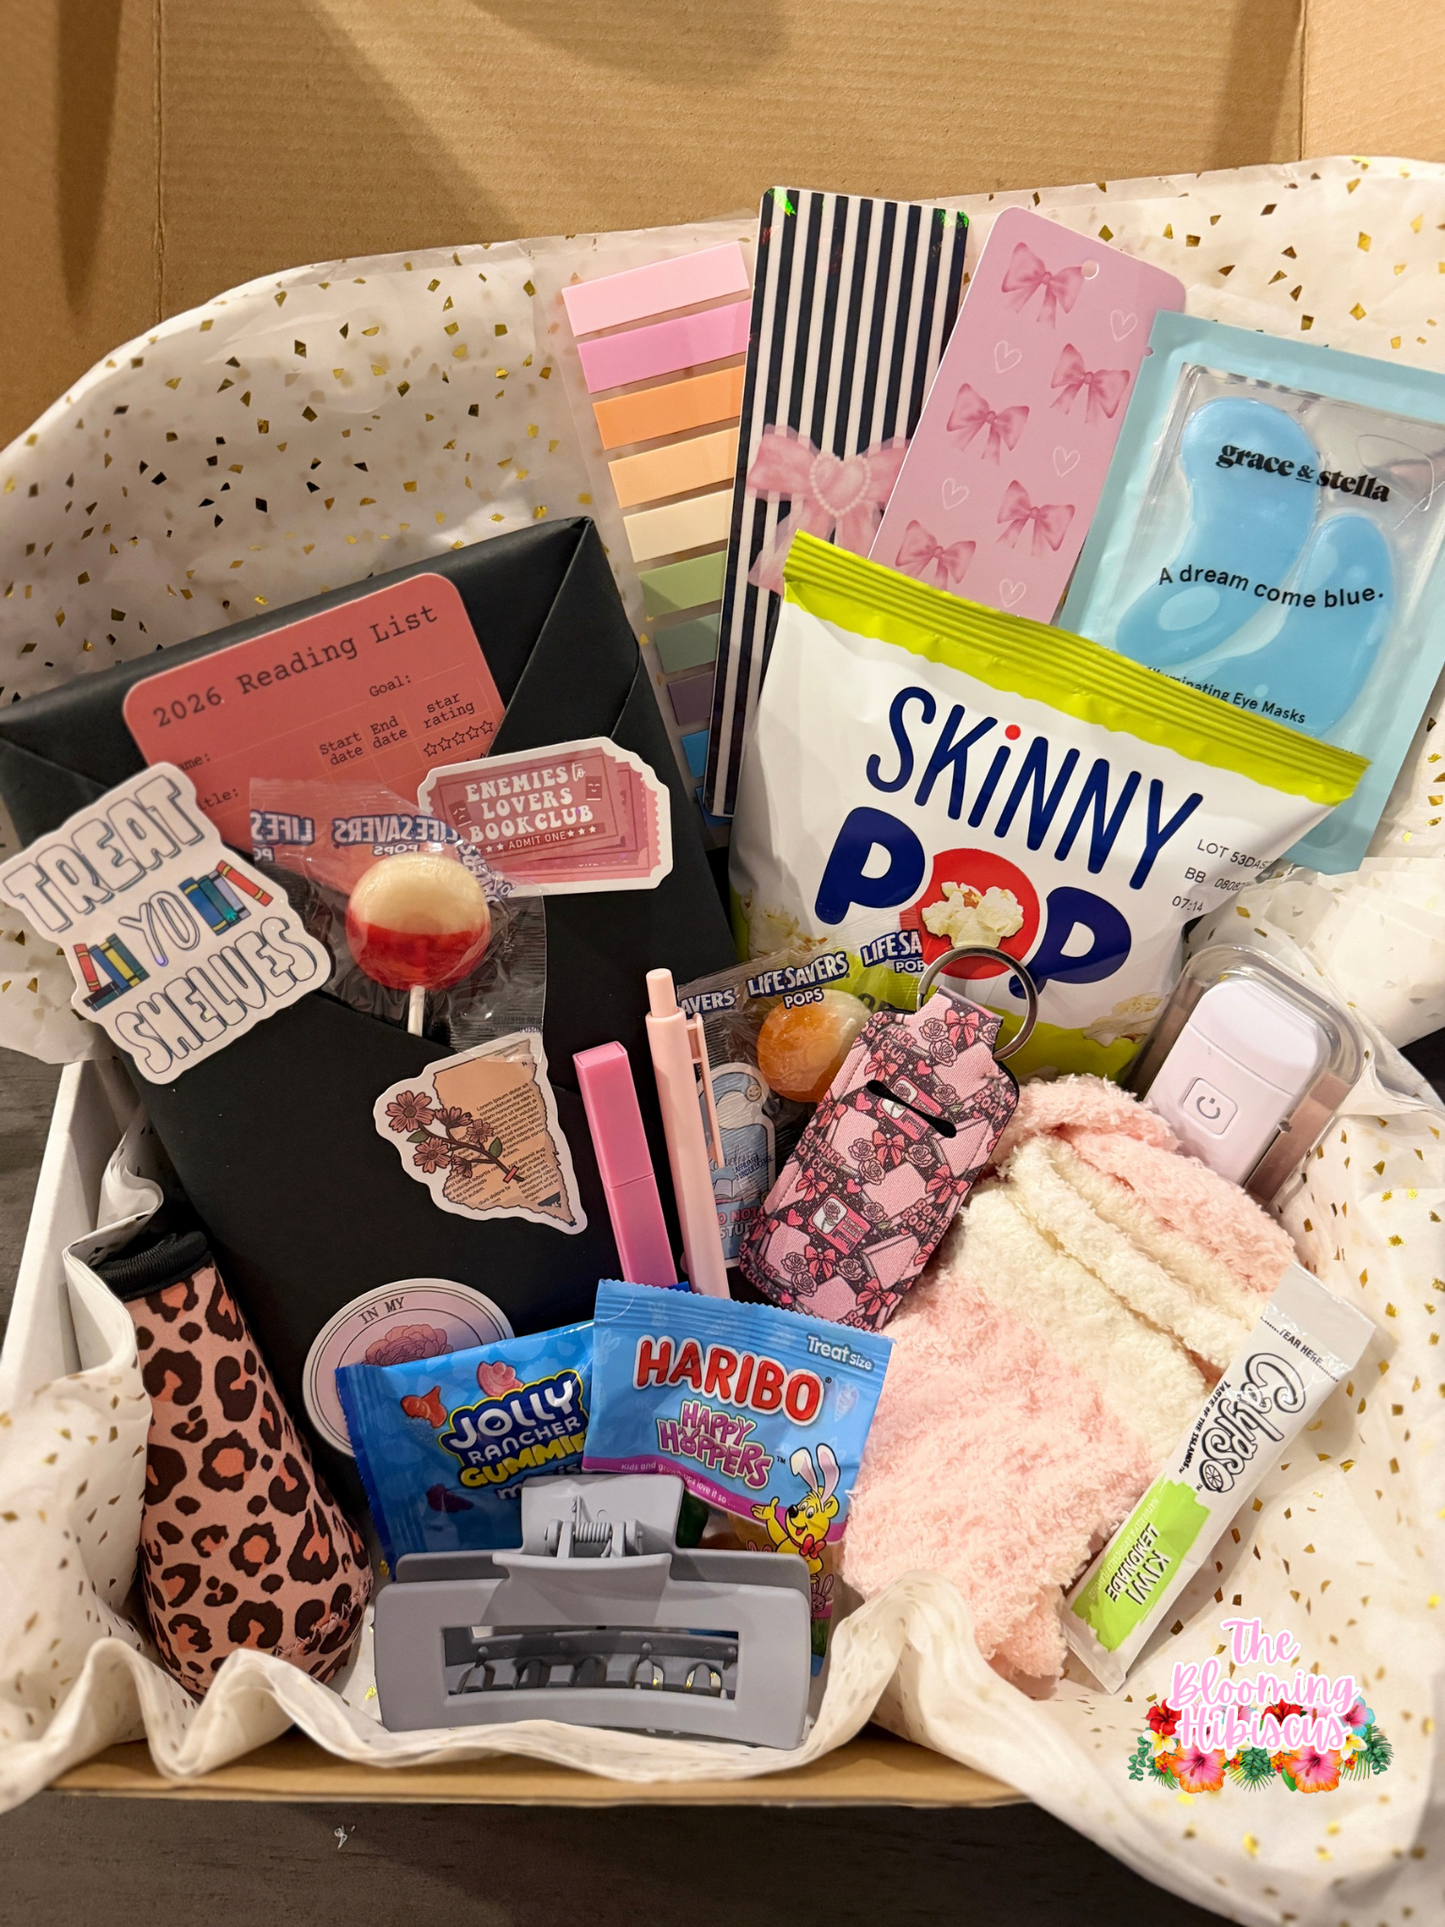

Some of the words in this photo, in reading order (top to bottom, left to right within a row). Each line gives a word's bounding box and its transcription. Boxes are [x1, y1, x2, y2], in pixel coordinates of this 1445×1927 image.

[1215, 443, 1295, 477] grace
[1295, 464, 1315, 484] &
[1316, 467, 1390, 502] stella
[1158, 566, 1173, 586] A
[1179, 564, 1249, 592] dream
[1253, 583, 1316, 608] come
[1324, 585, 1385, 608] blue.
[153, 686, 221, 727] 2026
[236, 637, 358, 695] Reading
[369, 603, 438, 645] List
[368, 674, 412, 698] Goal:
[423, 700, 476, 730] rating
[426, 692, 461, 714] star
[1232, 692, 1258, 710] Eye
[1261, 702, 1306, 724] Masks
[370, 716, 399, 737] End
[372, 728, 408, 750] date
[319, 731, 362, 756] Start
[330, 745, 364, 767] date
[177, 753, 211, 772] ame:
[465, 766, 569, 803] ENEMIES
[571, 762, 586, 782] to
[481, 787, 573, 820] LOVERS
[3, 775, 205, 933] TREAT
[508, 834, 541, 850] ADMIT
[544, 830, 566, 843] ONE
[1197, 839, 1229, 858] LOT
[1184, 867, 1206, 884] BB
[1171, 895, 1203, 912] 07:14
[118, 890, 200, 967] YO
[115, 916, 317, 1074] SHELVES
[785, 988, 823, 1009] POPS
[879, 1038, 907, 1064] CLUB
[810, 1157, 837, 1182] CLUB
[358, 1307, 379, 1325] IN
[385, 1297, 405, 1314] MY
[808, 1335, 849, 1362] Treat
[1280, 1329, 1301, 1348] TEAR
[1300, 1344, 1323, 1366] HERE
[635, 1337, 822, 1424] HARIBO
[1211, 1380, 1231, 1408] TASTE
[450, 1380, 574, 1449] JOLLY
[681, 1401, 755, 1447] HAPPY
[1196, 1417, 1205, 1432] THE
[1199, 1352, 1306, 1493] Calypso
[1203, 1406, 1211, 1419] OF
[468, 1416, 581, 1465] RANCHER
[657, 1419, 774, 1488] HOPPERS
[621, 1463, 639, 1471] Kids
[640, 1461, 656, 1470] and
[696, 1480, 711, 1496] love
[712, 1490, 718, 1499] it
[718, 1493, 727, 1504] so
[1104, 1522, 1160, 1602] LEMONADE
[1125, 1549, 1171, 1605] KIWI
